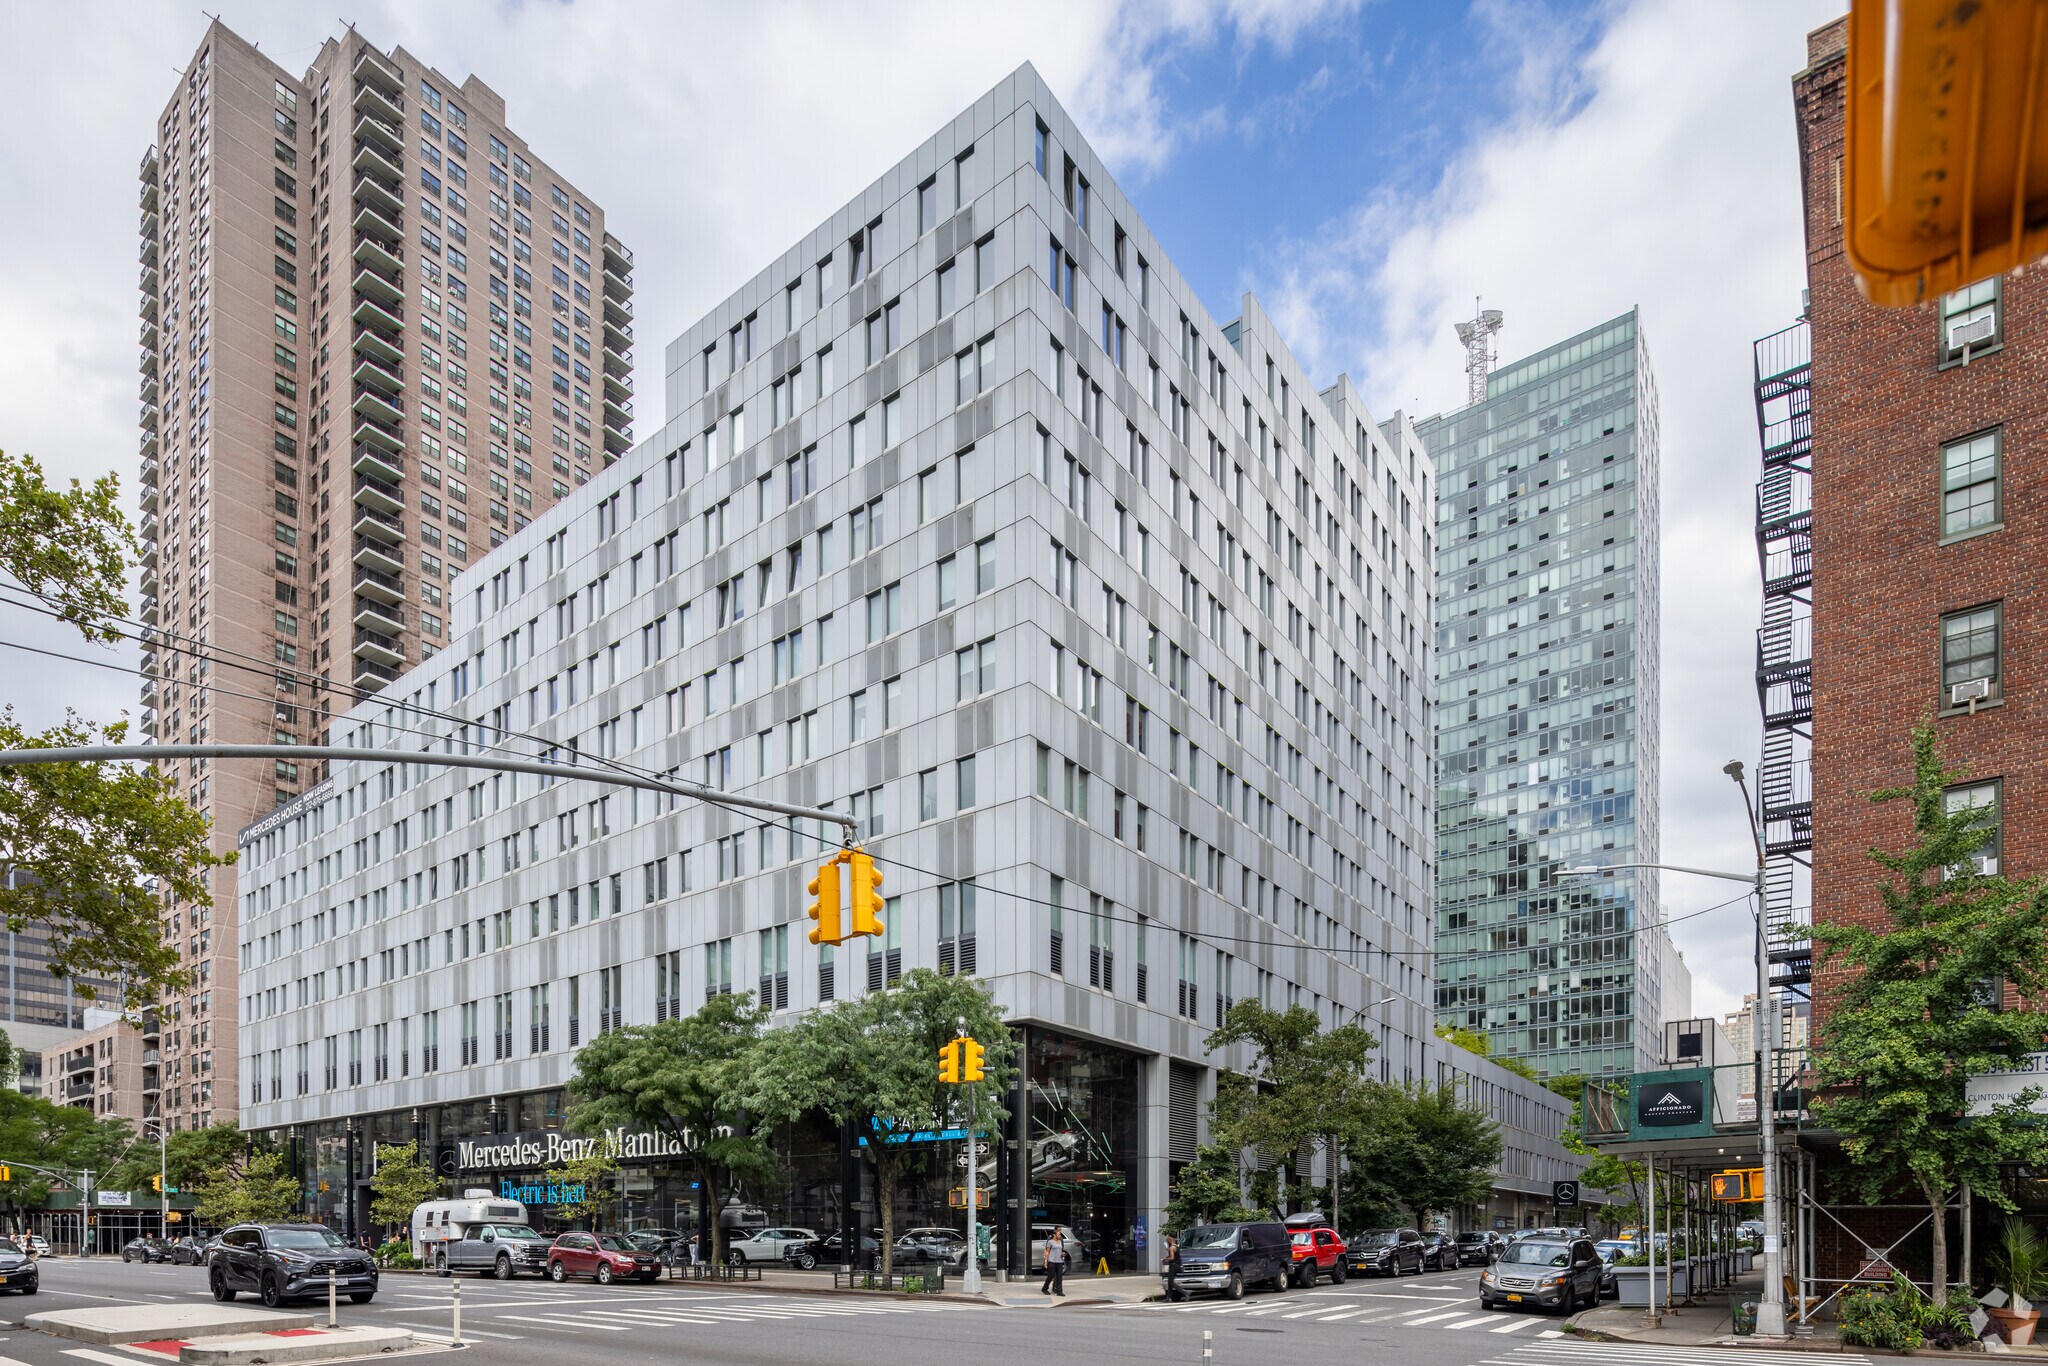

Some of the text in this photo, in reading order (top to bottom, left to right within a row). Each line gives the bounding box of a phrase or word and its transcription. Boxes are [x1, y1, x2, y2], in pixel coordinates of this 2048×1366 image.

[303, 779, 334, 803] NOW LEASING
[249, 799, 303, 840] MERCEDES HOUSE
[1967, 1093, 2005, 1102] CLINTON
[458, 1123, 735, 1170] Mercedes-Benz Manhatn
[501, 1180, 545, 1205] Electric
[547, 1179, 558, 1204] is
